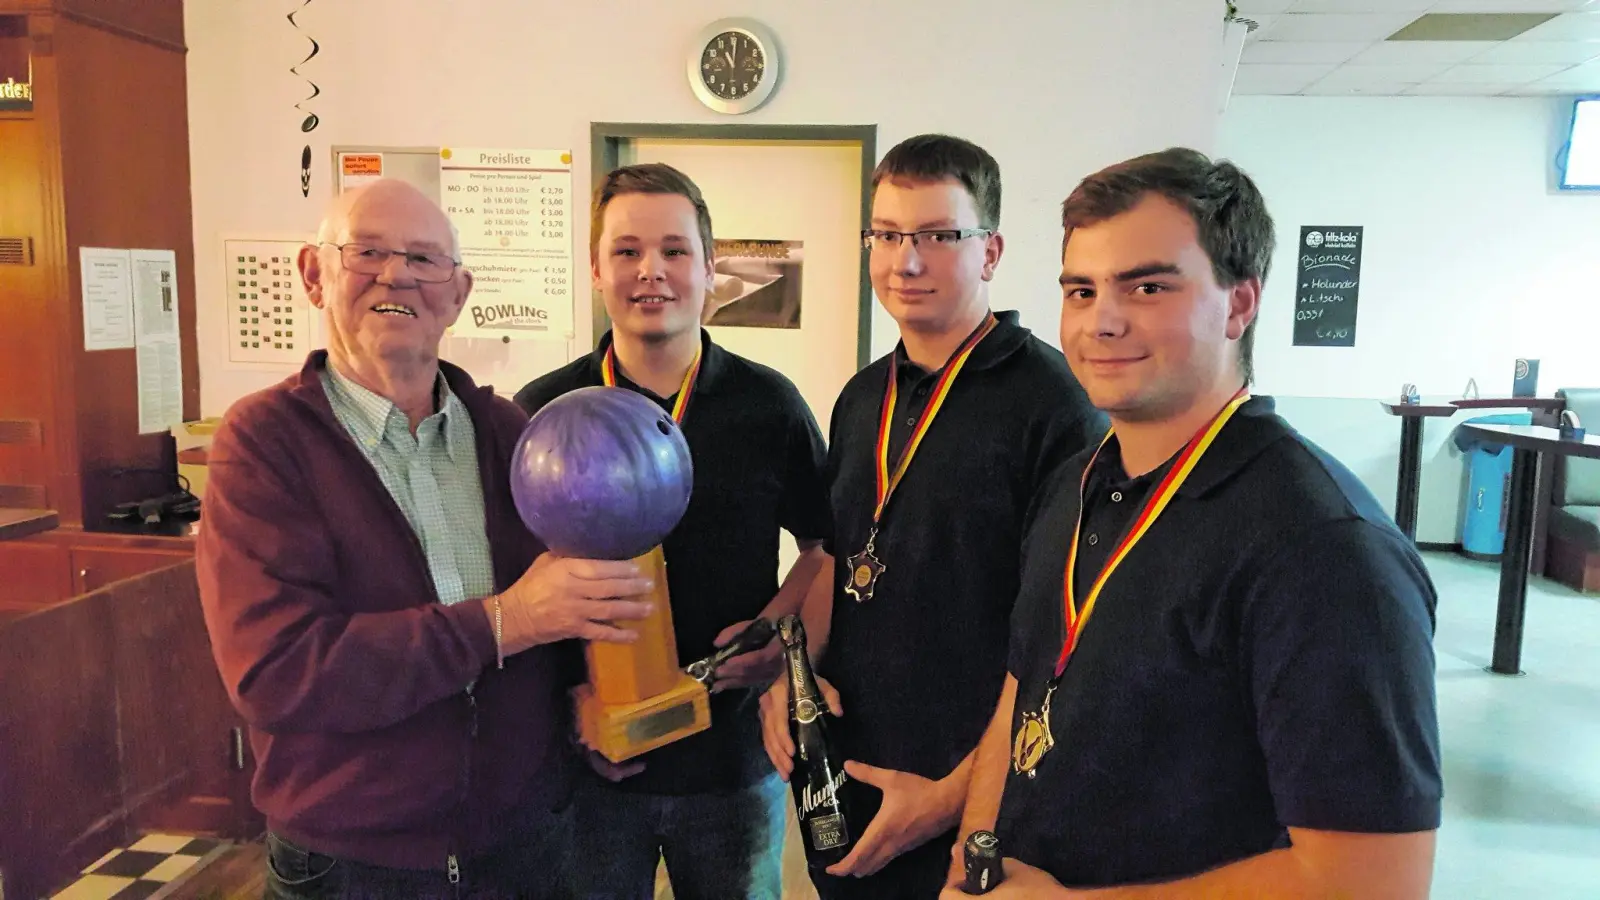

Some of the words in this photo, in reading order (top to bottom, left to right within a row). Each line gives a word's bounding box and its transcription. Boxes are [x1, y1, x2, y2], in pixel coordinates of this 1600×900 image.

[718, 40, 724, 49] 11
[710, 49, 716, 57] 10
[752, 48, 757, 57] 2
[753, 74, 758, 82] 4
[720, 83, 726, 92] 7
[743, 83, 748, 92] 5
[480, 153, 531, 164] Preisliste
[1301, 254, 1355, 268] Bionade
[1312, 278, 1357, 288] Holunder
[471, 304, 548, 328] BOWLING
[799, 770, 847, 820] Mumm
[819, 831, 840, 840] EXTRA
[824, 838, 838, 846] DRY
